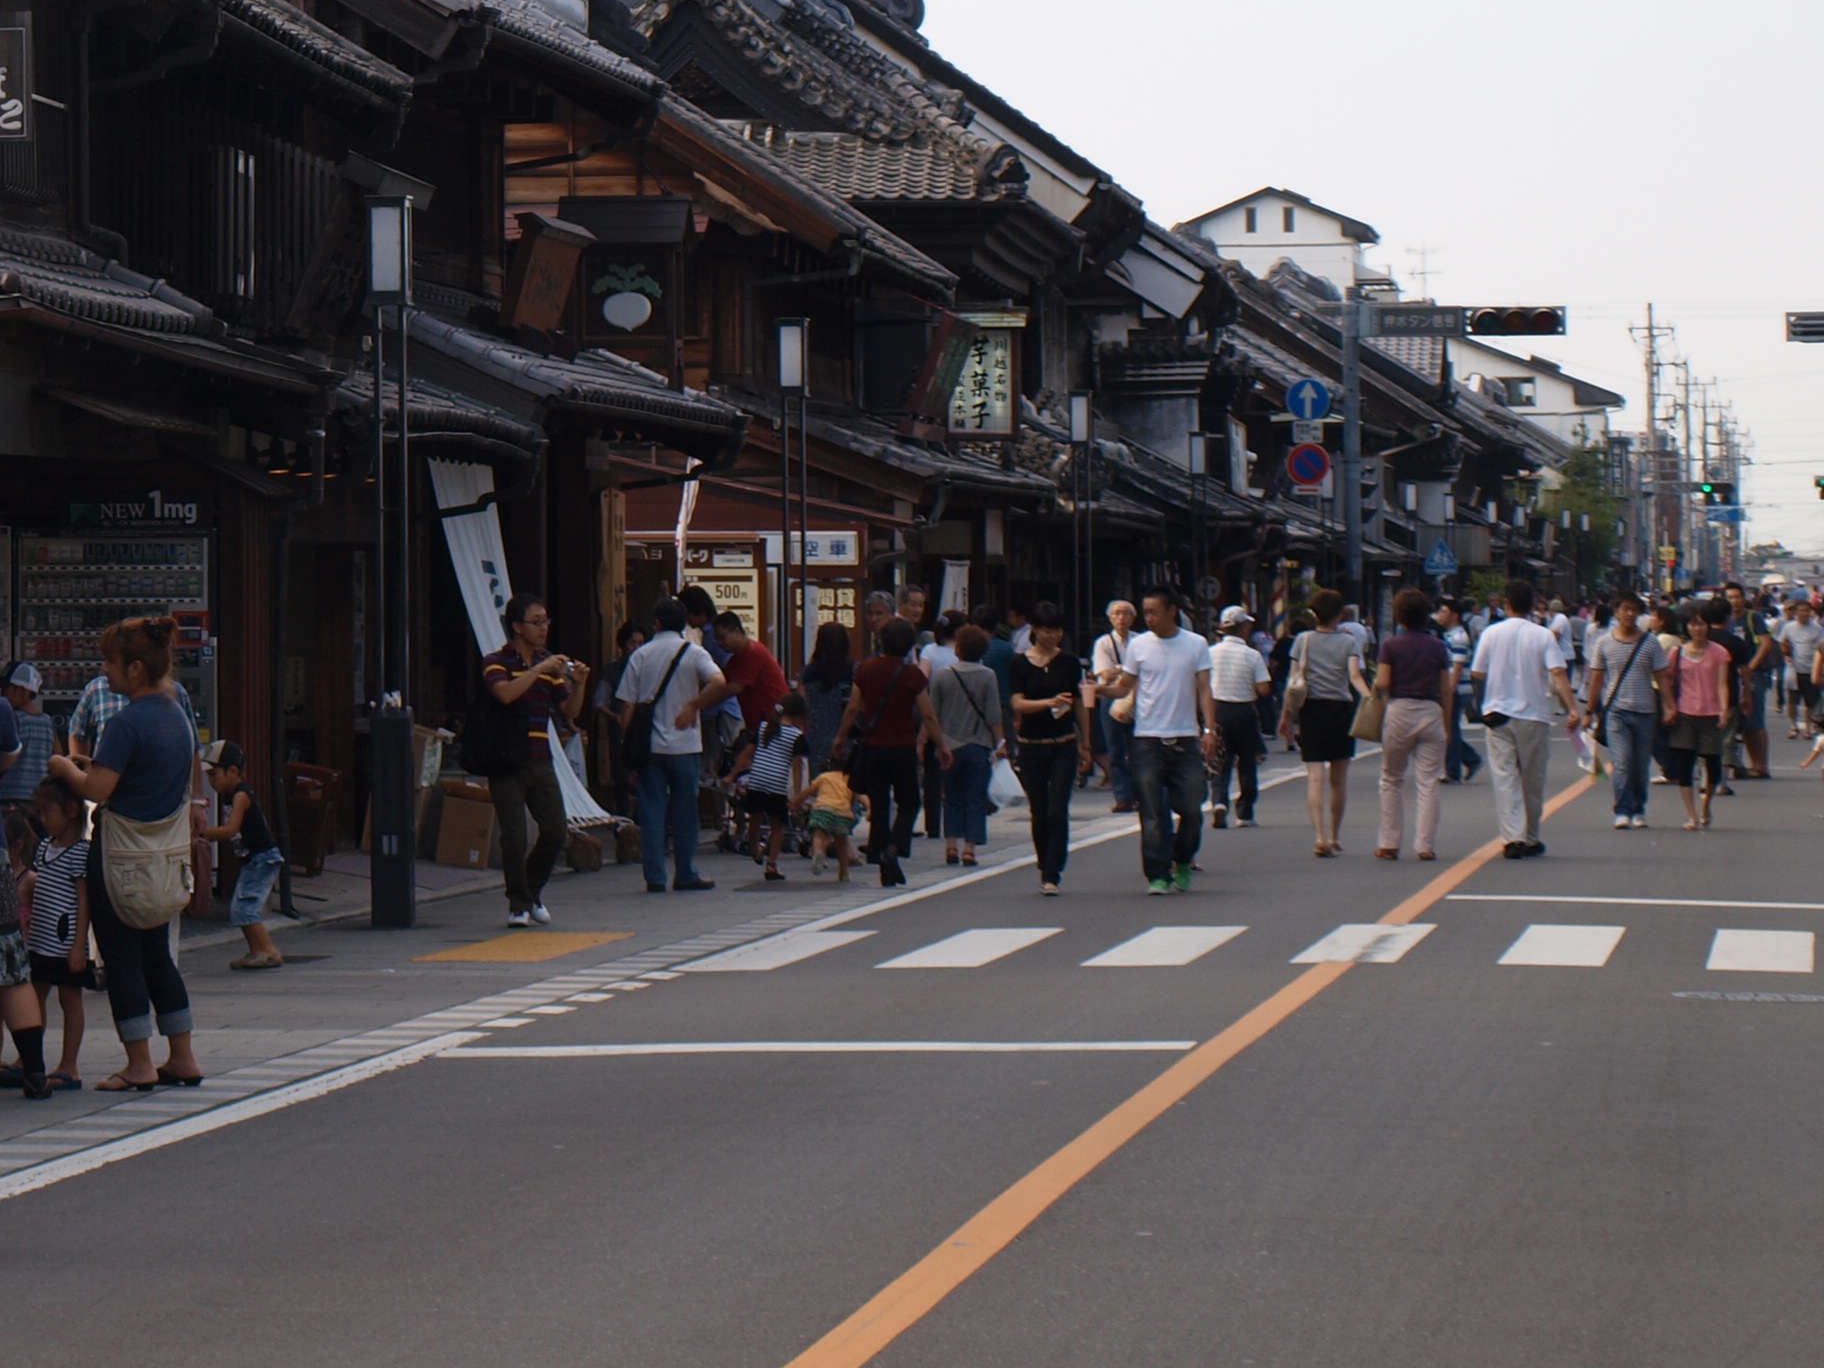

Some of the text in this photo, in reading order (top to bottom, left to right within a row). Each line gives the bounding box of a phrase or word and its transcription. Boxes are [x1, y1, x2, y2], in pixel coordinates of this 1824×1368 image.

[971, 334, 991, 429] 芋菓子
[994, 338, 1008, 402] 川越名物
[100, 489, 198, 525] NEW 1mg
[803, 539, 848, 558] 空車
